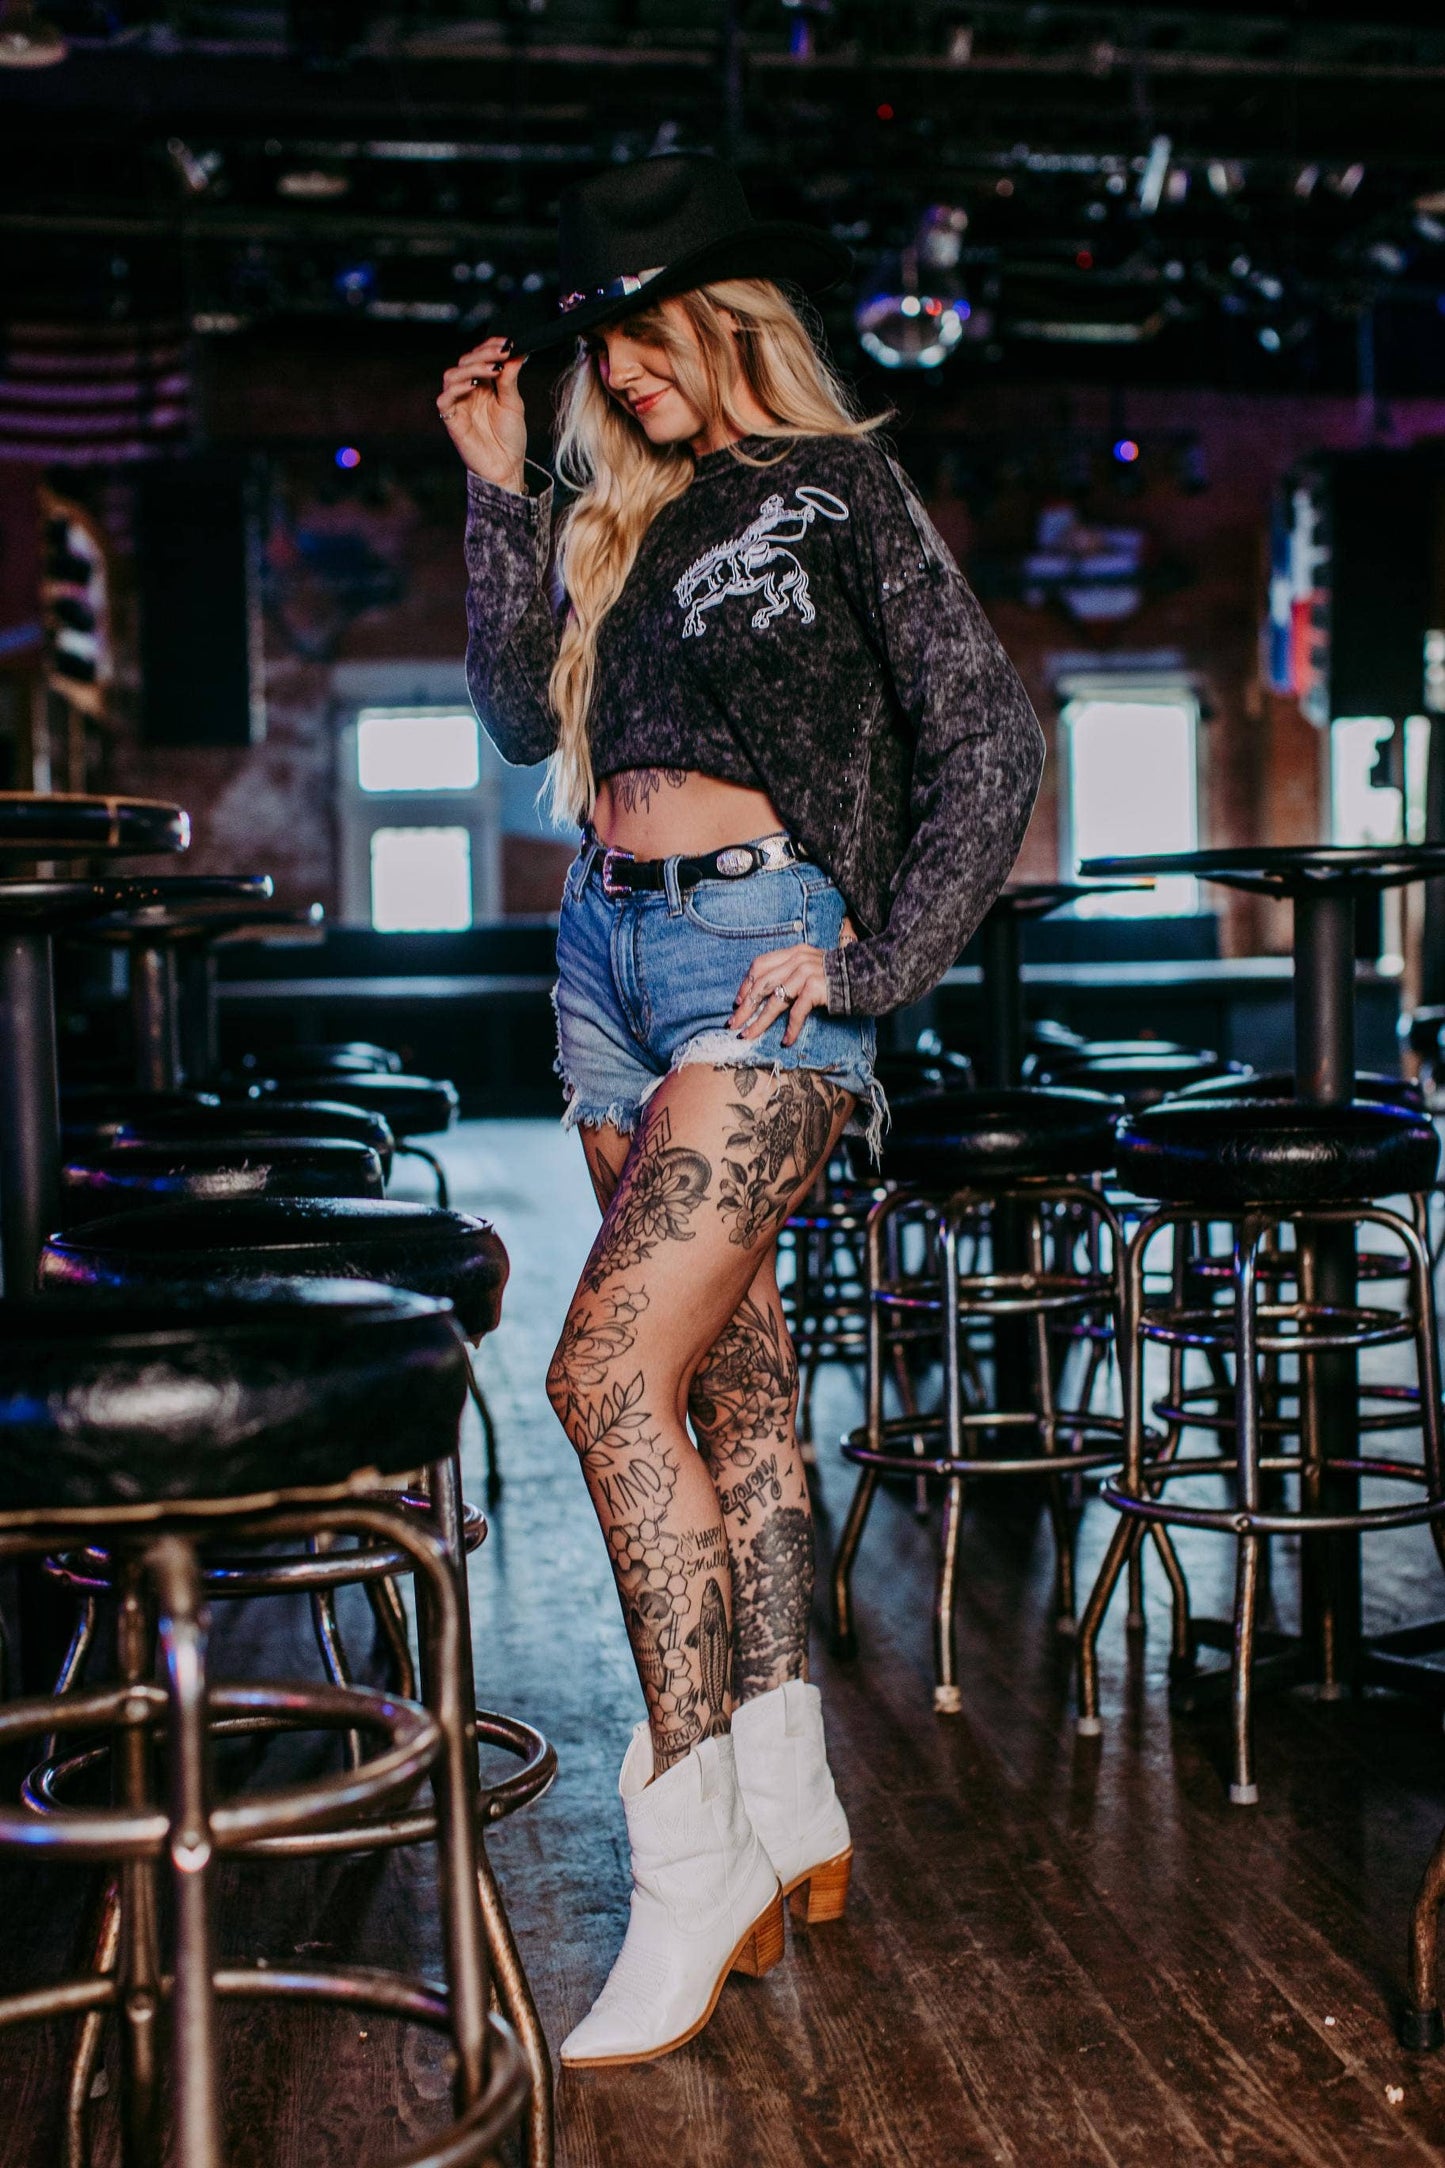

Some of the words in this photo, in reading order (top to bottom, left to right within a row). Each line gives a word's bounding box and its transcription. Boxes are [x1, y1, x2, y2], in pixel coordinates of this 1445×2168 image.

[598, 1459, 661, 1519] KIND
[716, 1453, 782, 1518] appy
[695, 1523, 722, 1550] HAPPY
